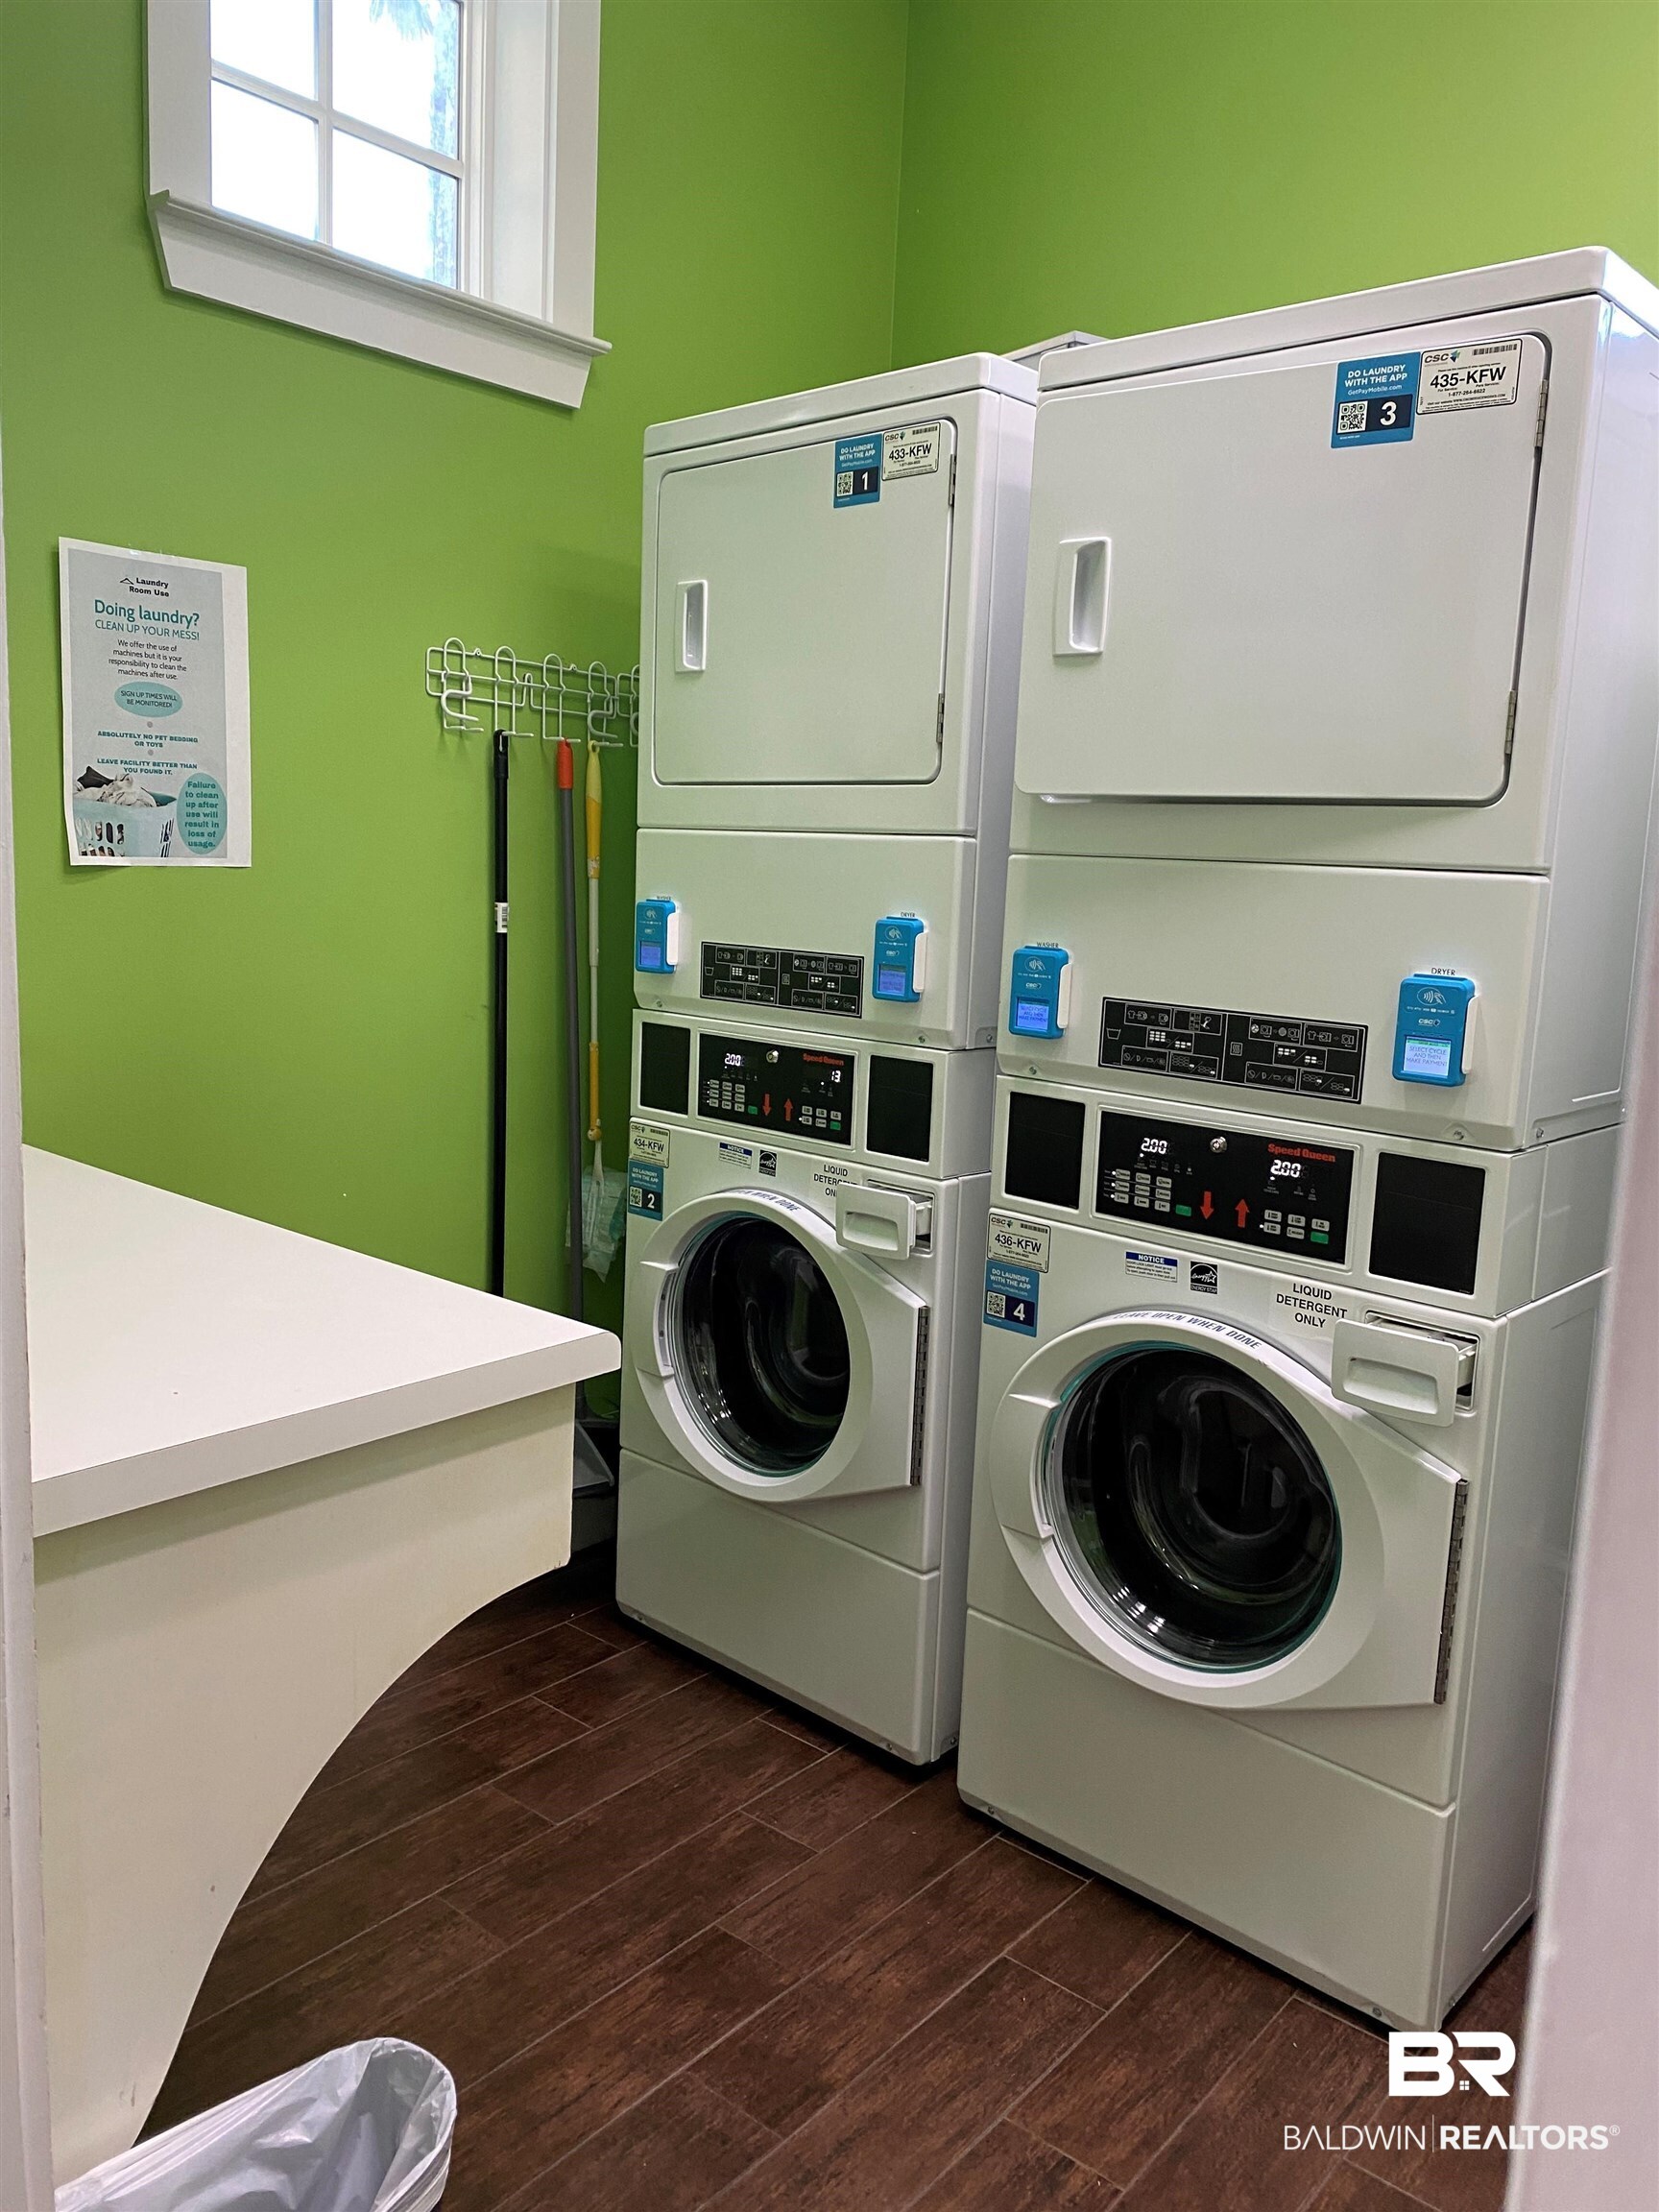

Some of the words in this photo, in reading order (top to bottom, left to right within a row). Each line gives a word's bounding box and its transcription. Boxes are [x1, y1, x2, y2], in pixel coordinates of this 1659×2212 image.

[1425, 353, 1449, 363] CSC
[1348, 369, 1361, 377] DO
[1363, 365, 1406, 376] LAUNDRY
[1431, 367, 1506, 388] 435-KFW
[1345, 377, 1368, 387] WITH
[1370, 375, 1387, 384] THE
[1389, 373, 1407, 382] APP
[1348, 384, 1402, 396] GetPayMobile.com
[1380, 401, 1397, 426] 3
[850, 444, 874, 452] LAUNDRY
[889, 444, 932, 460] 433-KFW
[861, 471, 868, 491] 1
[136, 577, 169, 589] Laundry
[130, 586, 152, 595] Room
[94, 599, 135, 622] Doing
[138, 605, 200, 629] laundry?
[95, 619, 124, 632] CLEAN
[127, 624, 140, 634] UP
[142, 626, 170, 637] YOUR
[172, 630, 200, 640] MESS!
[130, 640, 145, 649] offer
[146, 641, 157, 650] the
[113, 649, 143, 659] machines
[108, 658, 149, 669] responsibility
[159, 661, 176, 670] clean
[118, 668, 148, 677] machines
[150, 670, 164, 679] after
[196, 791, 219, 800] clean
[186, 802, 196, 810] up
[804, 1053, 823, 1063] Speed
[824, 1056, 844, 1066] Queen
[831, 1070, 841, 1083] 13
[634, 1138, 664, 1152] 434-KFW
[1268, 1142, 1300, 1157] Speed
[1302, 1149, 1336, 1163] Queen
[824, 1165, 848, 1177] LIQUID
[826, 1188, 836, 1197] ON
[647, 1193, 655, 1209] 2
[995, 1234, 1041, 1253] 436-KFW
[1139, 1254, 1165, 1264] NOTICE
[1002, 1271, 1029, 1283] LAUNDRY
[1293, 1283, 1332, 1300] LIQUID
[1013, 1303, 1025, 1321] 4
[1277, 1293, 1347, 1318] DETERGENT
[1295, 1312, 1326, 1328] ONLY
[1152, 1312, 1186, 1321] OPEN
[1188, 1317, 1225, 1332] WHEN
[1226, 1330, 1262, 1349] DONE
